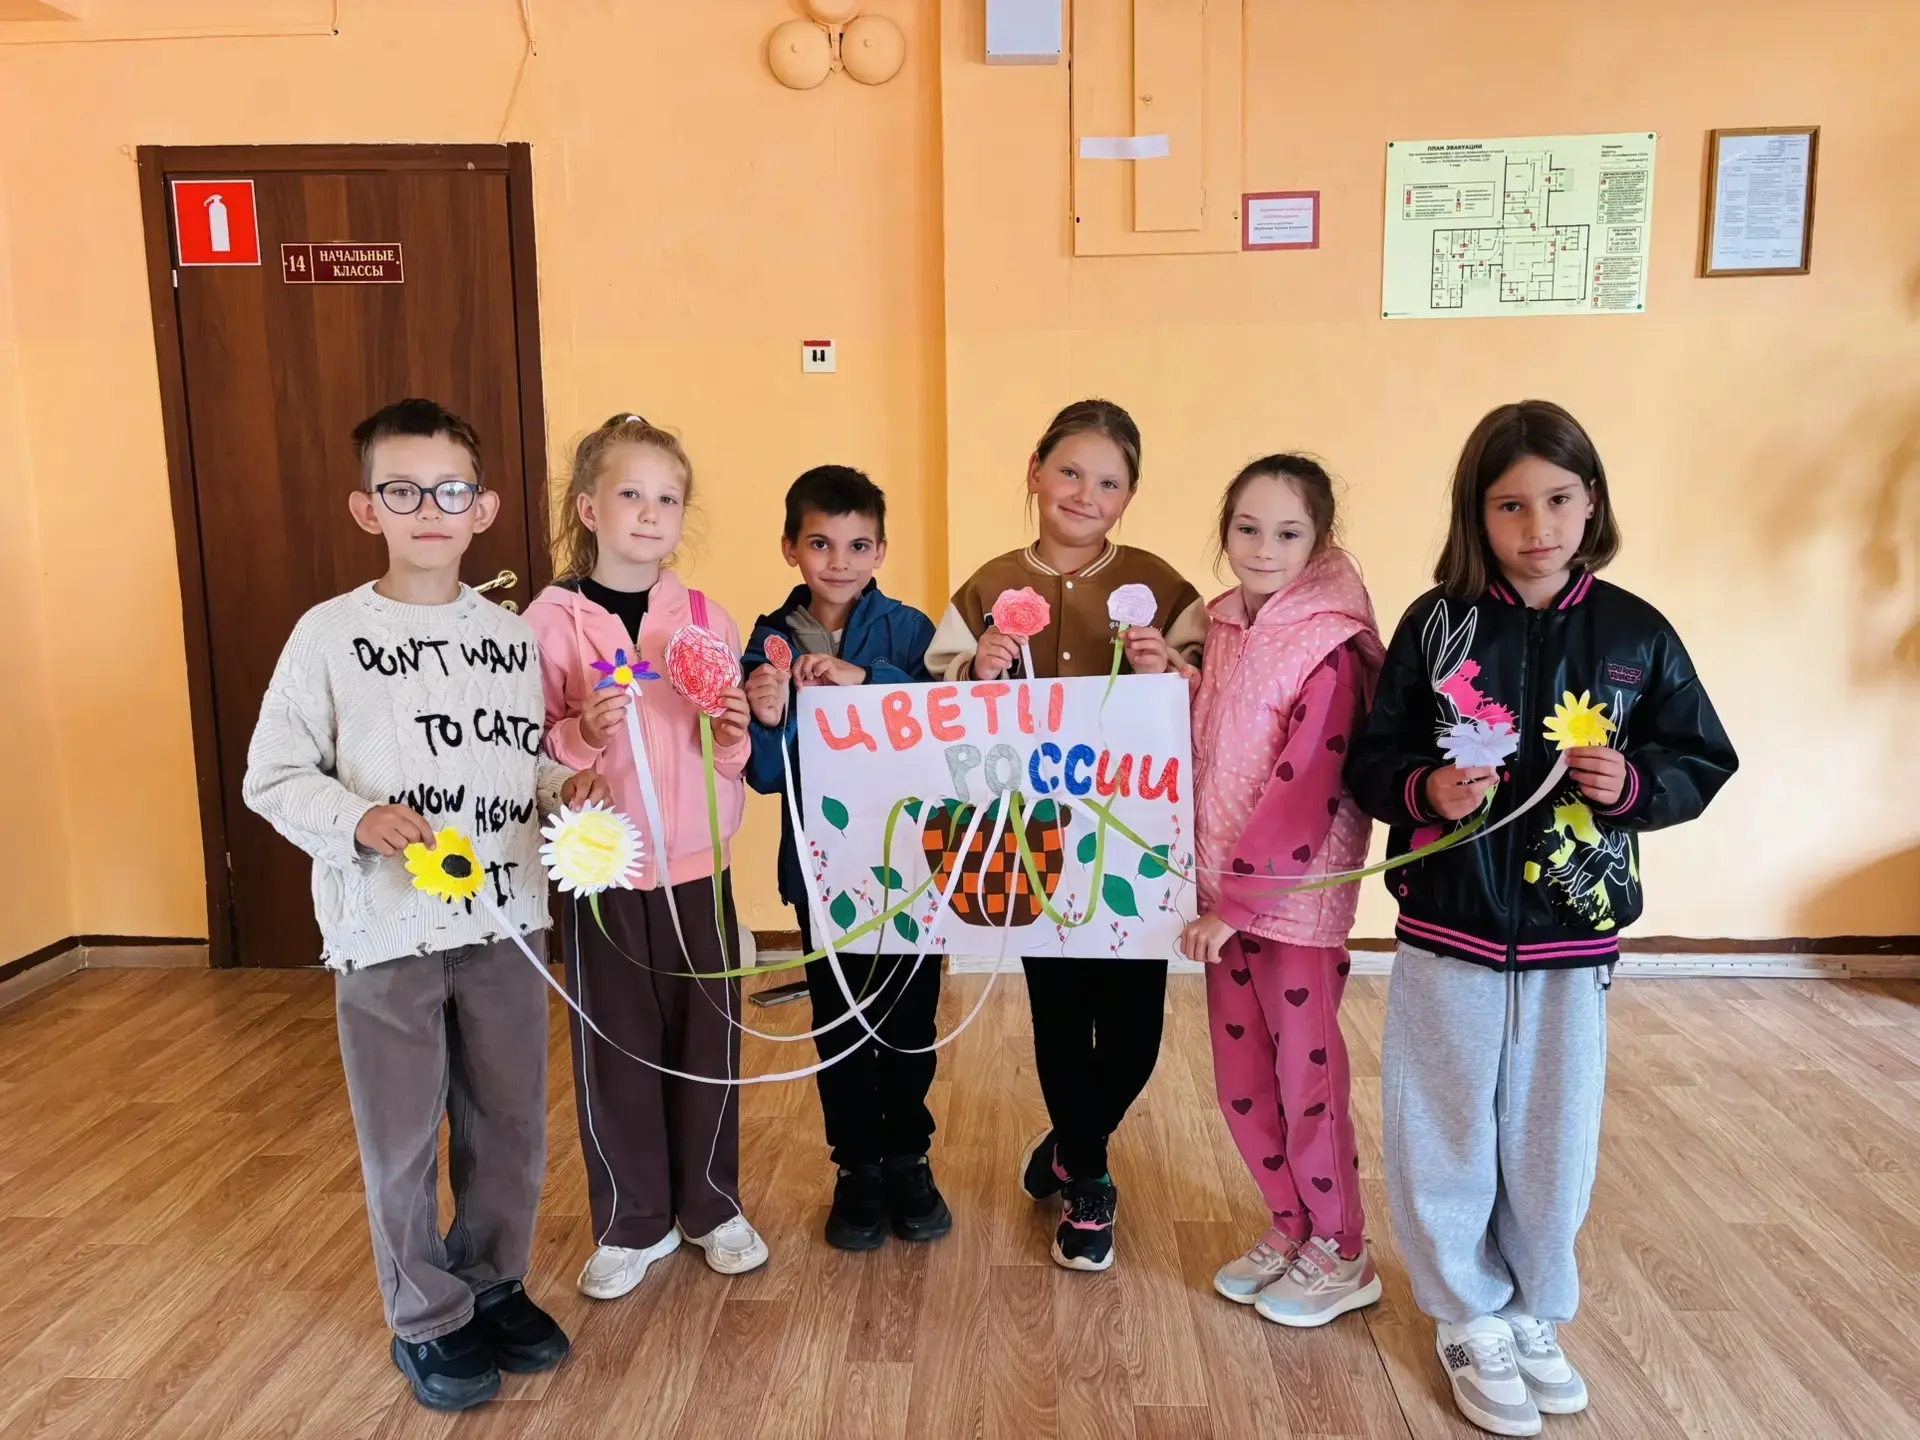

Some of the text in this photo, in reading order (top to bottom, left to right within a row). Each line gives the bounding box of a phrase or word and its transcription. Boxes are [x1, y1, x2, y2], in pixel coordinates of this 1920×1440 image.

[1446, 143, 1483, 151] ЭВАКУАЦИИ
[289, 254, 307, 273] 14
[319, 250, 395, 262] НАЧАЛЬНЫЕ
[333, 265, 384, 277] КЛАССЫ
[352, 637, 449, 677] DON'T
[414, 714, 463, 757] TO
[814, 682, 1064, 753] ЦВЕТЫ
[944, 742, 1180, 804] РОССИИ
[475, 796, 534, 837] HOW
